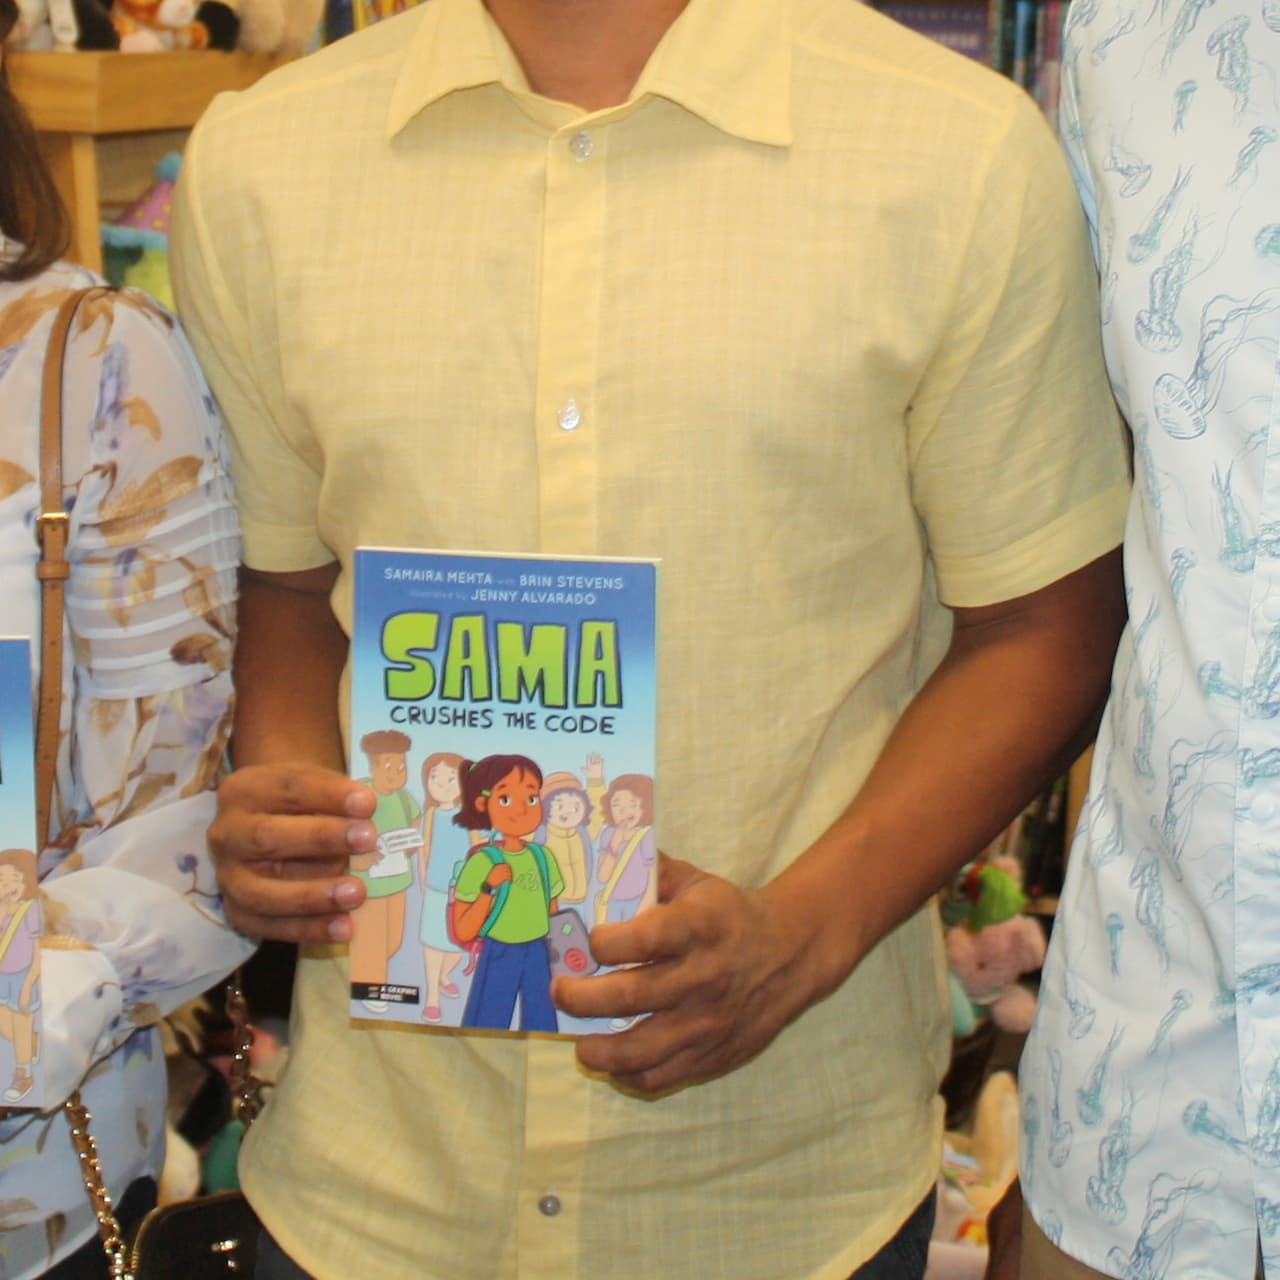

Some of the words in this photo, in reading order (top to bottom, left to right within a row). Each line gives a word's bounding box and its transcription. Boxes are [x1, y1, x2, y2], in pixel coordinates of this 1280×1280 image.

[383, 568, 444, 583] SAMAIRA
[447, 572, 493, 585] MEHTA
[519, 576, 552, 588] BRIN
[556, 576, 624, 590] STEVENS
[470, 588, 518, 602] JENNY
[520, 591, 597, 605] ALVARADO
[380, 610, 623, 709] SAMA
[389, 705, 495, 730] CRUSHES
[502, 710, 538, 730] THE
[544, 714, 617, 736] CODE
